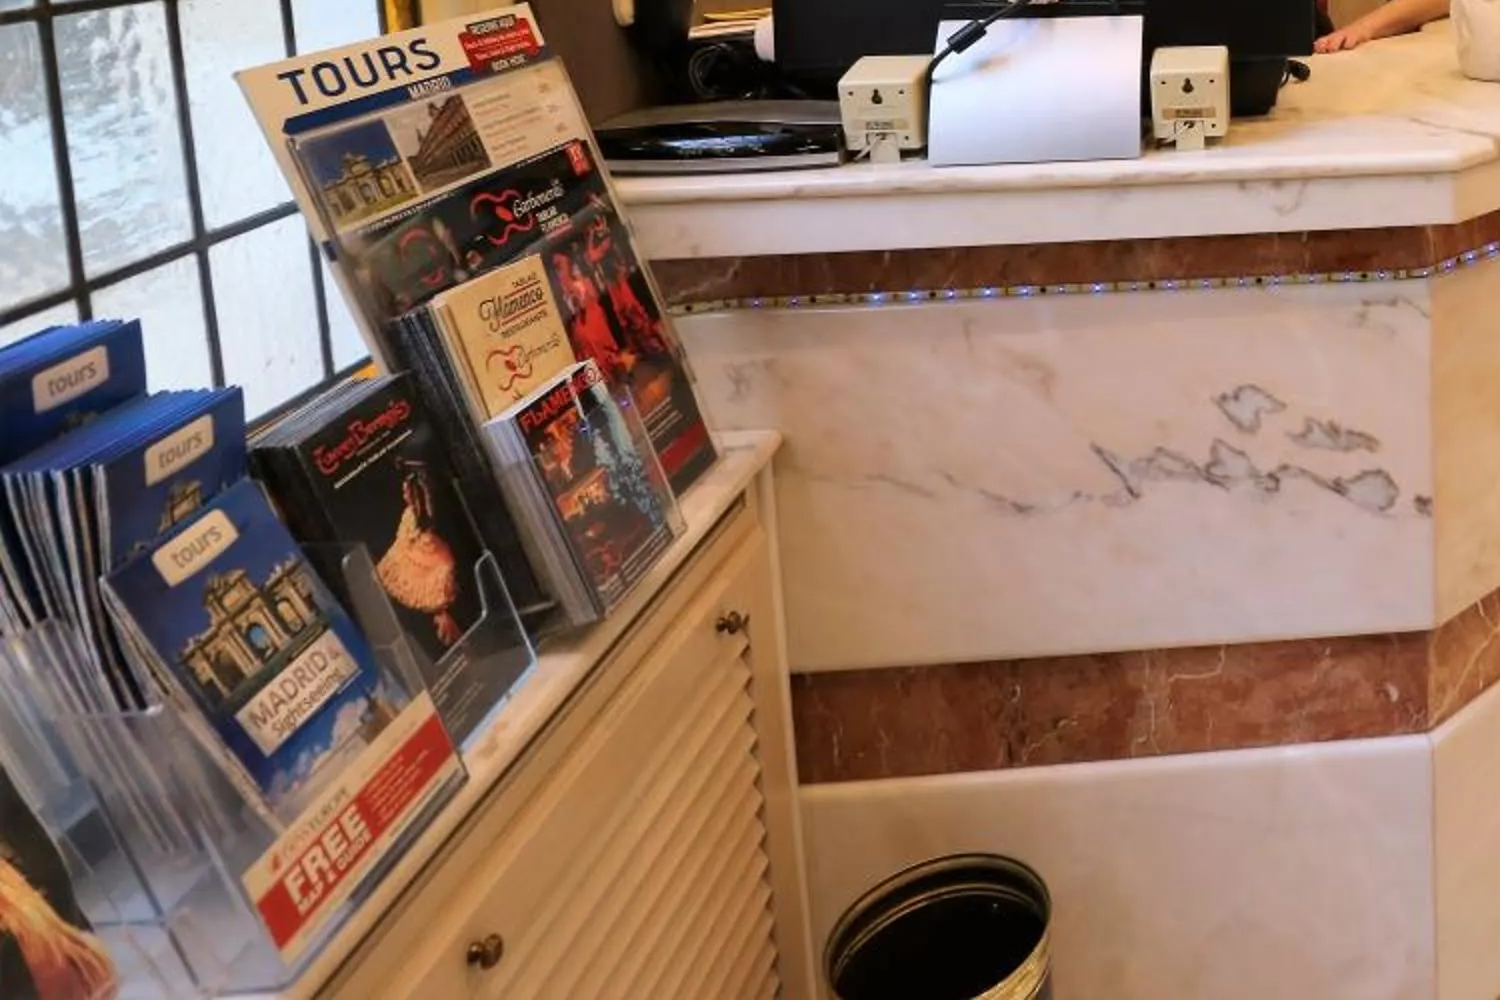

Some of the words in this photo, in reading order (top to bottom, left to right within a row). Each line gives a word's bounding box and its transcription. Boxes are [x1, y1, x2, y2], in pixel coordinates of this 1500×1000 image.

[276, 37, 443, 105] TOURS
[407, 75, 452, 100] MADRID
[46, 361, 97, 395] tours
[157, 431, 203, 469] tours
[169, 525, 223, 569] tours
[247, 651, 331, 729] MADRID
[283, 805, 371, 904] FREE
